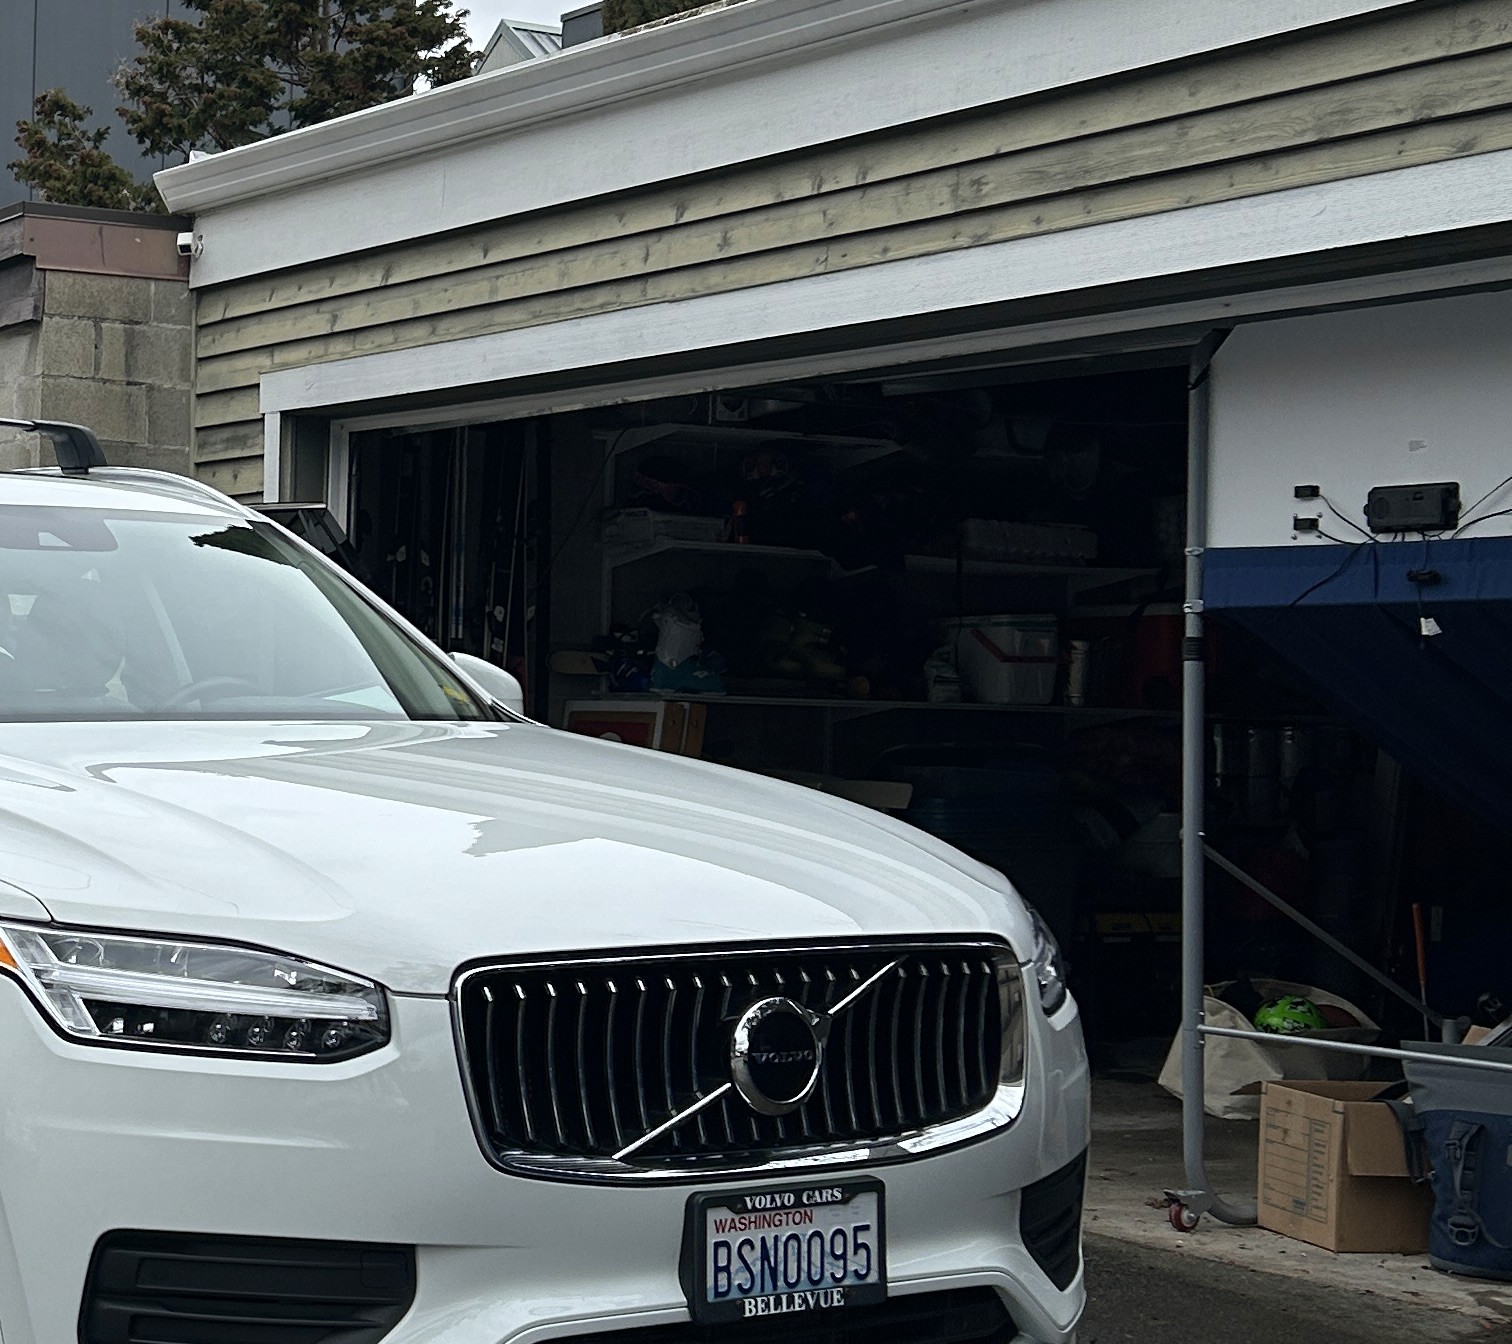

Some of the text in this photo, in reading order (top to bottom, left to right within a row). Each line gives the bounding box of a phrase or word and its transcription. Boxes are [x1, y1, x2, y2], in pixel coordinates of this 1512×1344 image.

[744, 1188, 843, 1210] VOLVO CARS
[714, 1209, 813, 1234] WASHINGTON
[713, 1223, 872, 1299] BSN0095
[743, 1288, 845, 1318] BELLEVUE
